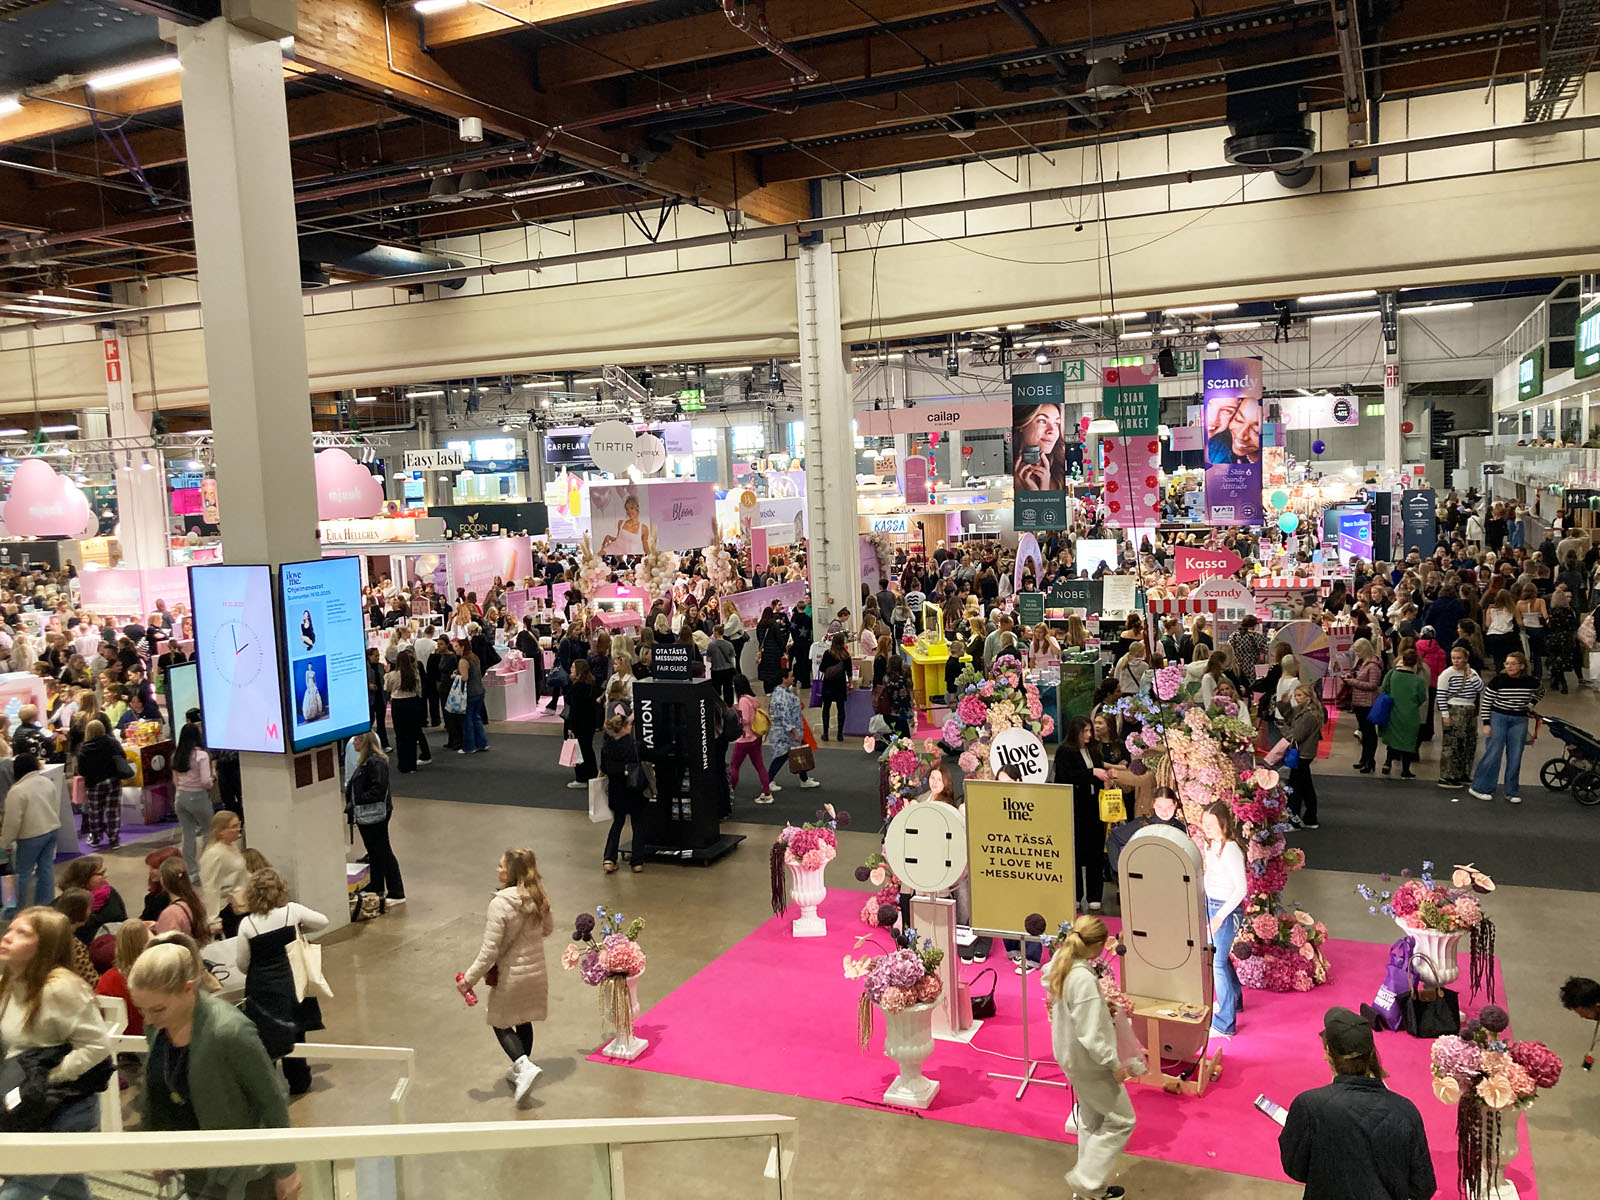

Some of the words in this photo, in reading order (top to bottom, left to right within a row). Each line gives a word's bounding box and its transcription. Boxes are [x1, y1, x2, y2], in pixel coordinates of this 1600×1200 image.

[1207, 374, 1258, 392] scandy
[1017, 385, 1053, 396] NOBE
[927, 411, 960, 423] cailap
[547, 443, 585, 451] CARPELAN
[595, 442, 634, 452] TIRTIR
[406, 453, 434, 469] Easy
[437, 450, 462, 466] lash
[672, 502, 693, 521] Bloom
[459, 523, 488, 532] FOODIN
[874, 519, 905, 532] KASSA
[344, 527, 380, 540] HELLGREN
[1185, 557, 1228, 570] Kassa
[1056, 590, 1085, 599] NOBE
[1204, 588, 1242, 600] scandy
[668, 647, 688, 655] TÄSTÄ
[669, 664, 688, 672] GUIDE
[699, 699, 709, 770] INFORMATION
[996, 743, 1040, 766] ilove
[1003, 797, 1035, 812] ilove
[1008, 810, 1033, 821] me.
[987, 833, 1011, 843] OTA
[1015, 833, 1054, 846] TÄSSÄ
[981, 844, 1061, 859] VIRALLINEN
[989, 857, 996, 866] I
[1000, 858, 1031, 868] LOVE
[1035, 860, 1053, 870] ME
[980, 869, 1063, 883] -MESSUKUVA!
